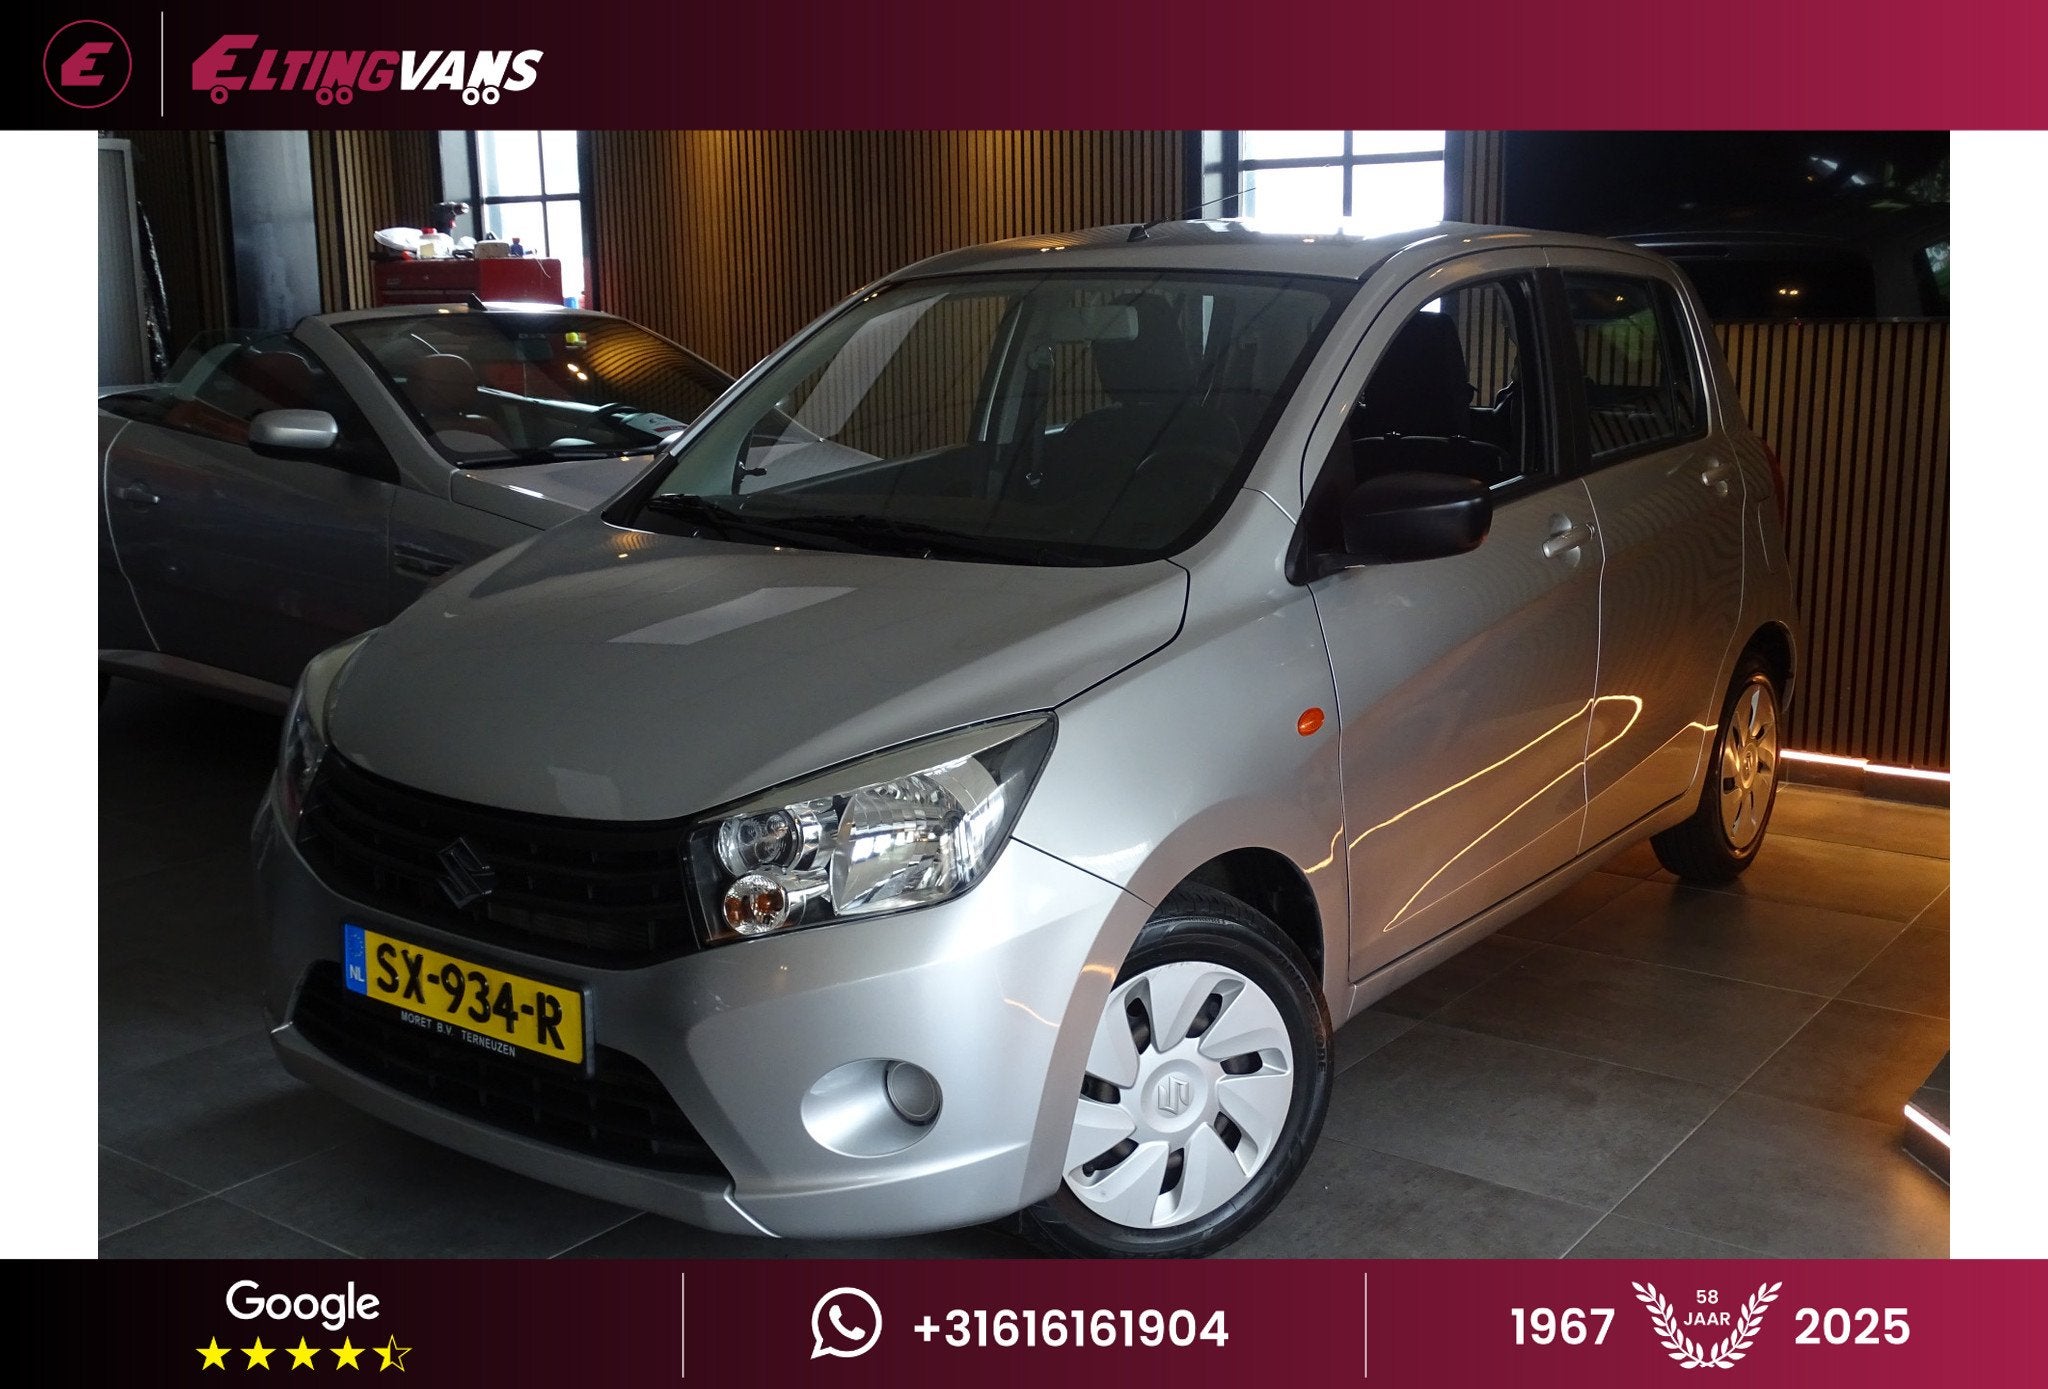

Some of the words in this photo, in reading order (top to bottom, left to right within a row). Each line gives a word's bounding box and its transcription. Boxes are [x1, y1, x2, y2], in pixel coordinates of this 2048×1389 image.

[349, 964, 364, 983] NL
[376, 942, 565, 1050] SX-934-R
[401, 1010, 432, 1030] MORET
[461, 1030, 516, 1057] TERNEUZEN
